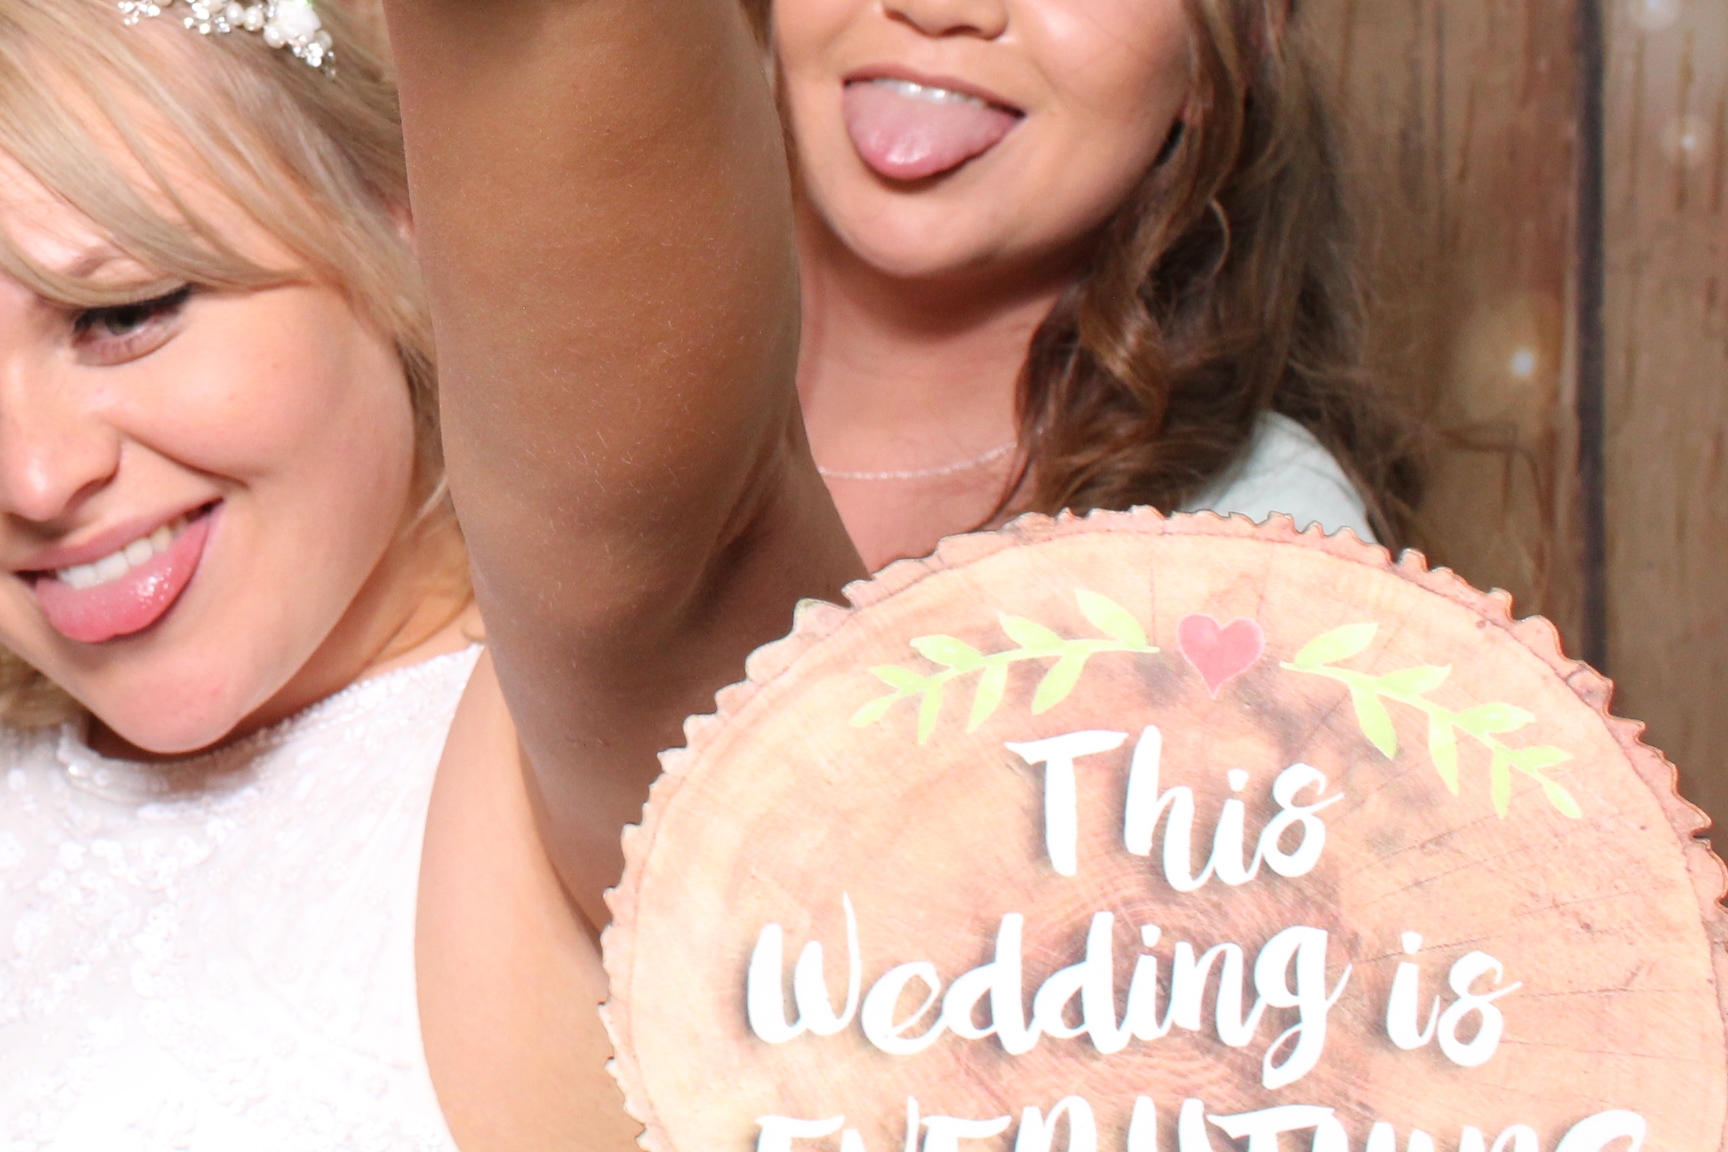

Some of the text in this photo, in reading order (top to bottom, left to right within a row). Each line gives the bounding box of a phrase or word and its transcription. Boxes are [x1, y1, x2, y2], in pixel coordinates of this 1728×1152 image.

[1003, 723, 1345, 893] This
[745, 890, 1525, 1091] Wedding is
